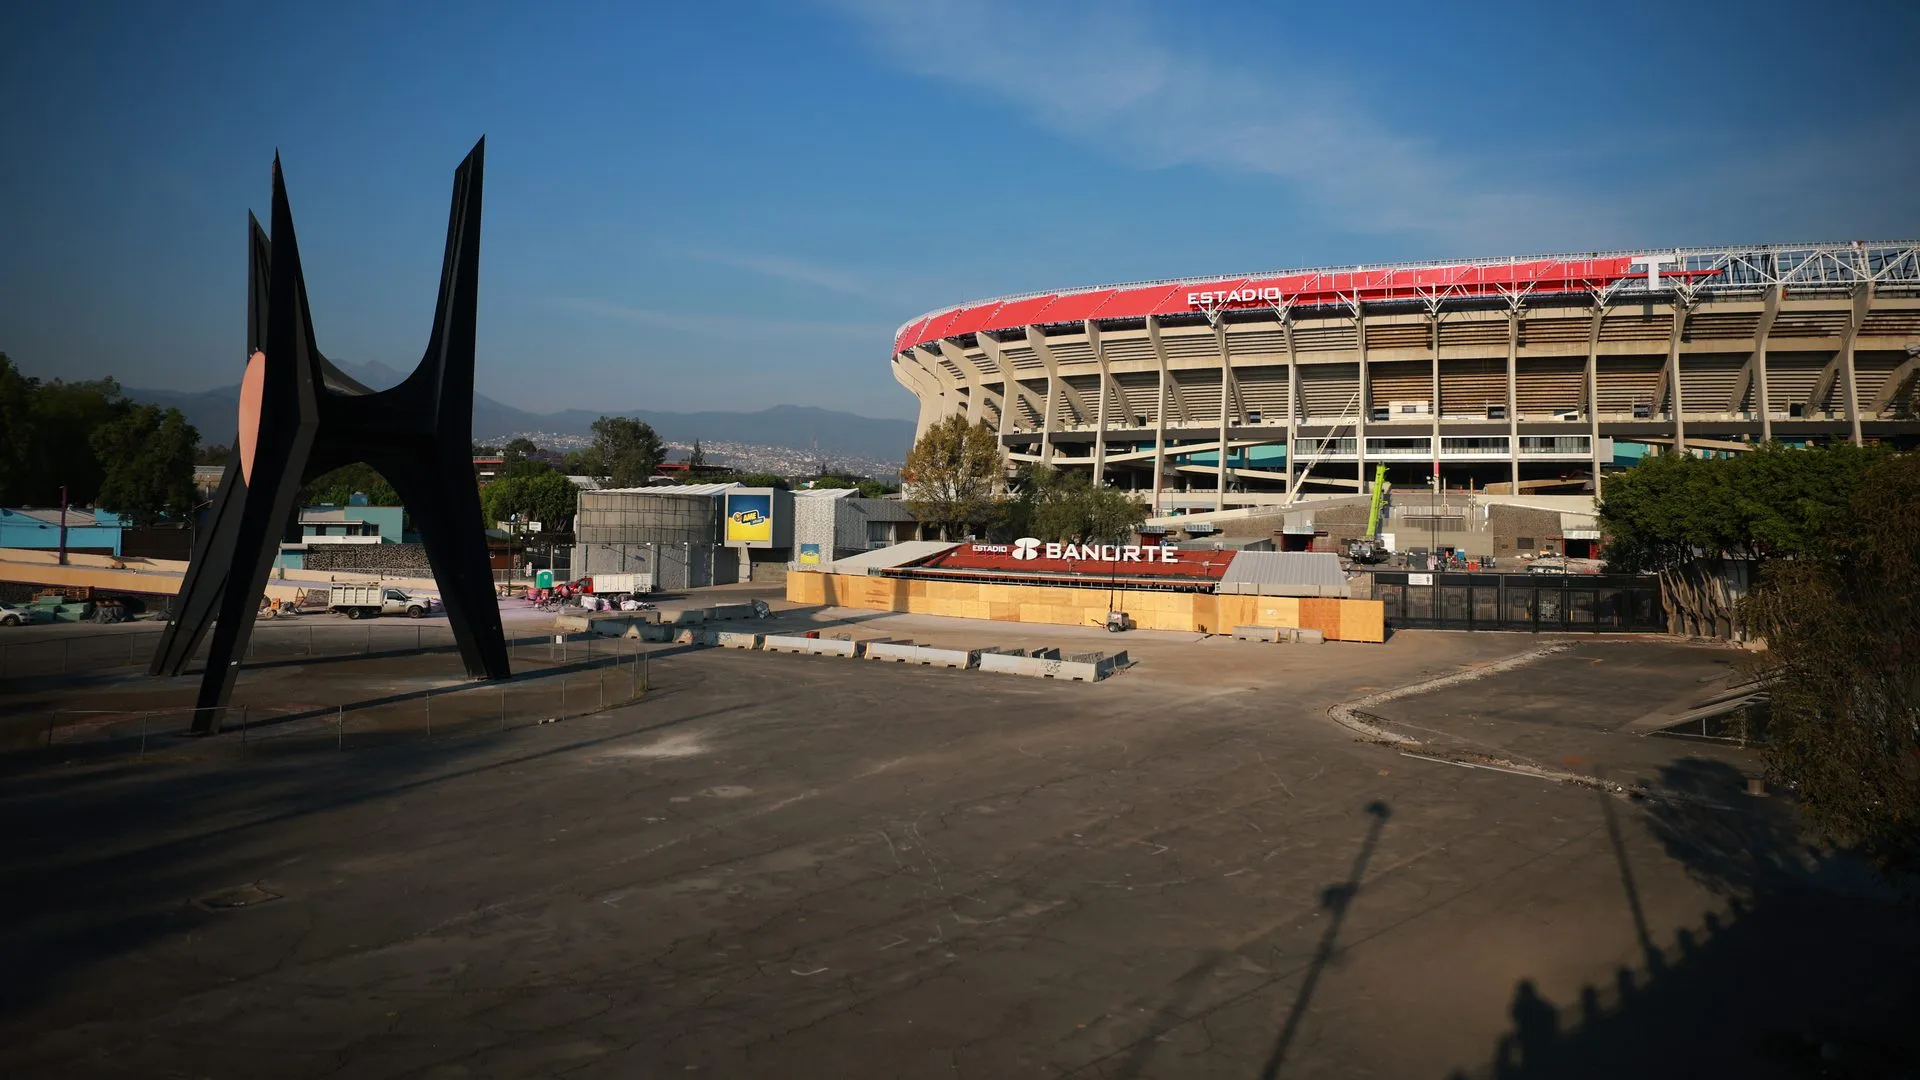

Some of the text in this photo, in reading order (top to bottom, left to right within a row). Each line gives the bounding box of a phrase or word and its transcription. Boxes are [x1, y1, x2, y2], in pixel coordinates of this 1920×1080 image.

[1187, 255, 1676, 305] ESTADIO T
[972, 543, 1178, 563] ESTADIO BANORTE
